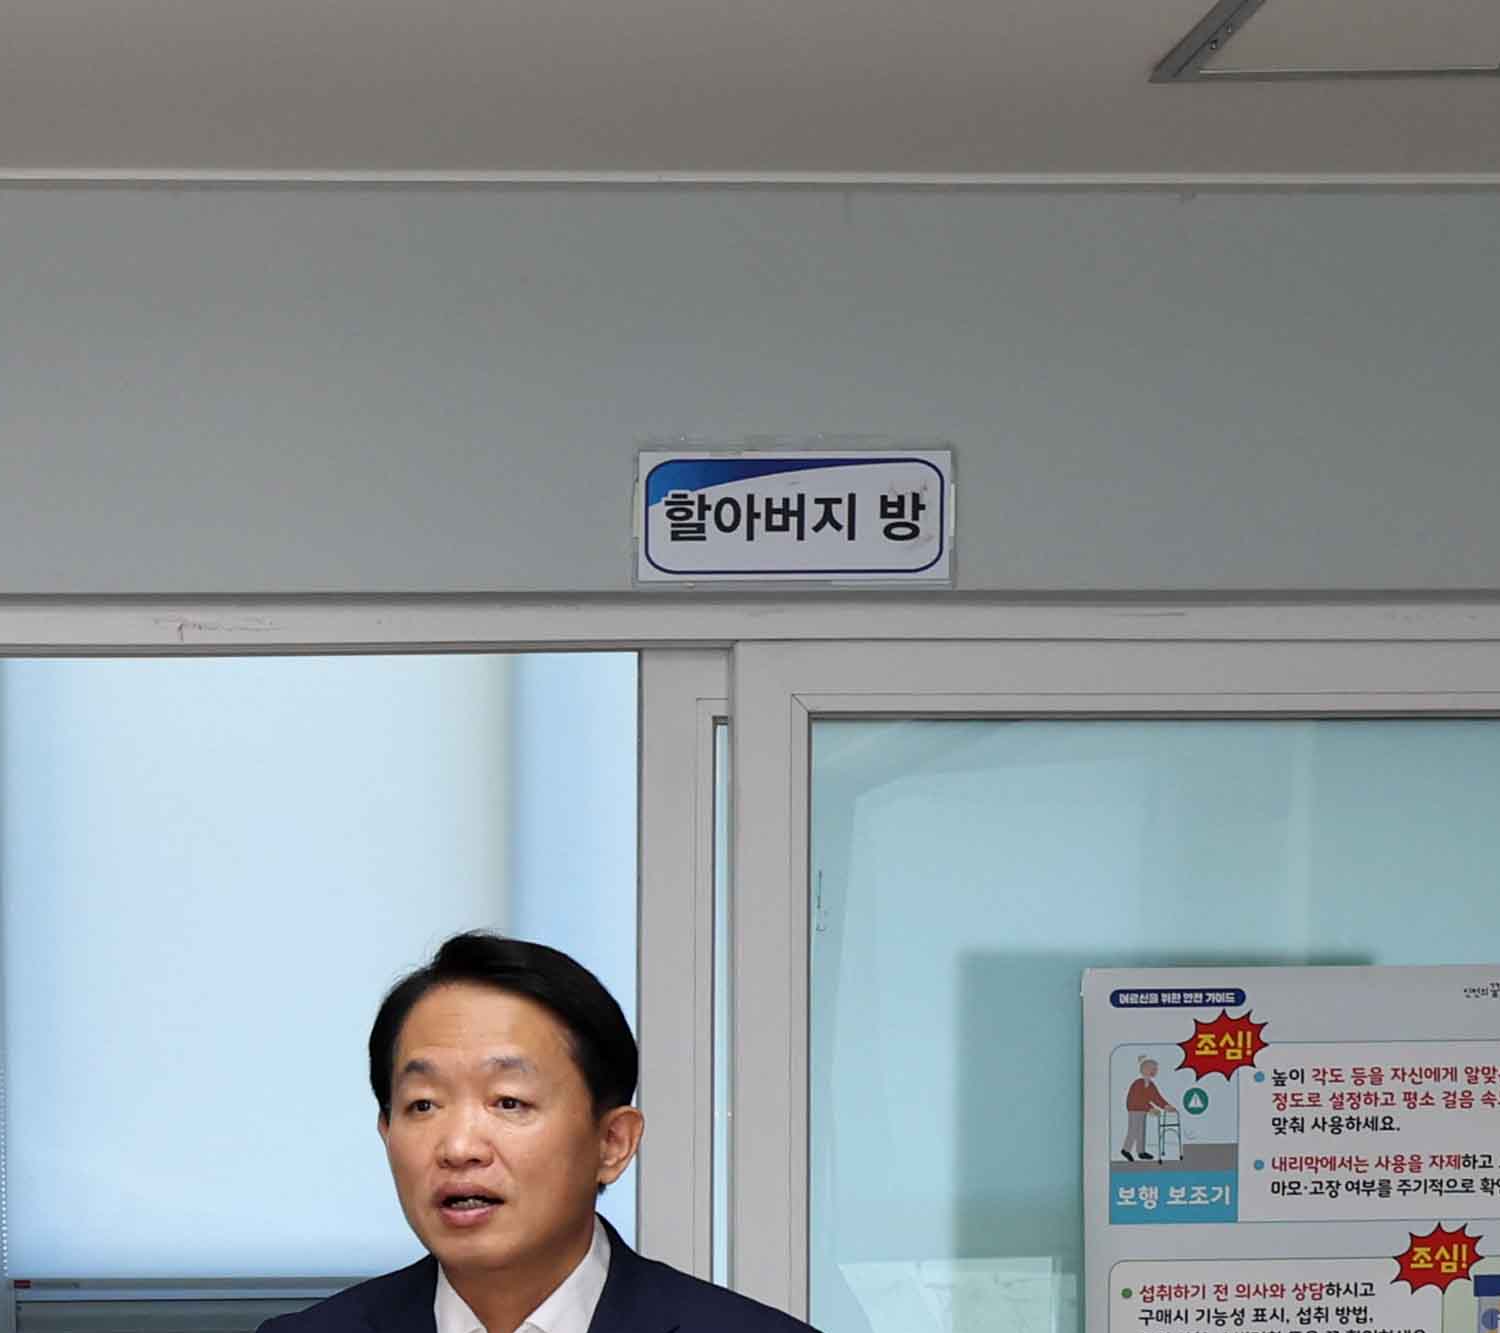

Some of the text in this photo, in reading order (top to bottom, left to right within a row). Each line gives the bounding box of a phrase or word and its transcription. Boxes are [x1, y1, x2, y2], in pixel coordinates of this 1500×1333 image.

[664, 493, 926, 541] 할아버지 방
[1205, 991, 1236, 1003] 가이드
[1195, 1031, 1252, 1060] 조심!
[1271, 1067, 1305, 1088] 높이
[1311, 1066, 1346, 1087] 각도
[1349, 1066, 1385, 1086] 등을
[1389, 1065, 1459, 1086] 자신에게
[1271, 1091, 1324, 1112] 정도로
[1328, 1090, 1398, 1111] 설정하고
[1401, 1090, 1436, 1110] 평소
[1441, 1089, 1476, 1110] 걸음
[1271, 1114, 1401, 1136] 맞춰 사용하세요.
[1271, 1154, 1370, 1175] 내리막에서는
[1374, 1153, 1425, 1174] 사용을
[1428, 1152, 1495, 1171] 자제하고
[1116, 1184, 1230, 1209] 보행 보조기
[1344, 1178, 1393, 1198] 여부를
[1395, 1177, 1477, 1198] 주기적으로
[1410, 1246, 1468, 1273] 조심!
[1138, 1280, 1377, 1303] 섭취하기 전 의사와 상담하시고
[1137, 1307, 1189, 1327] 구매시
[1194, 1306, 1246, 1327] 기능성
[1295, 1305, 1330, 1326] 섭취
